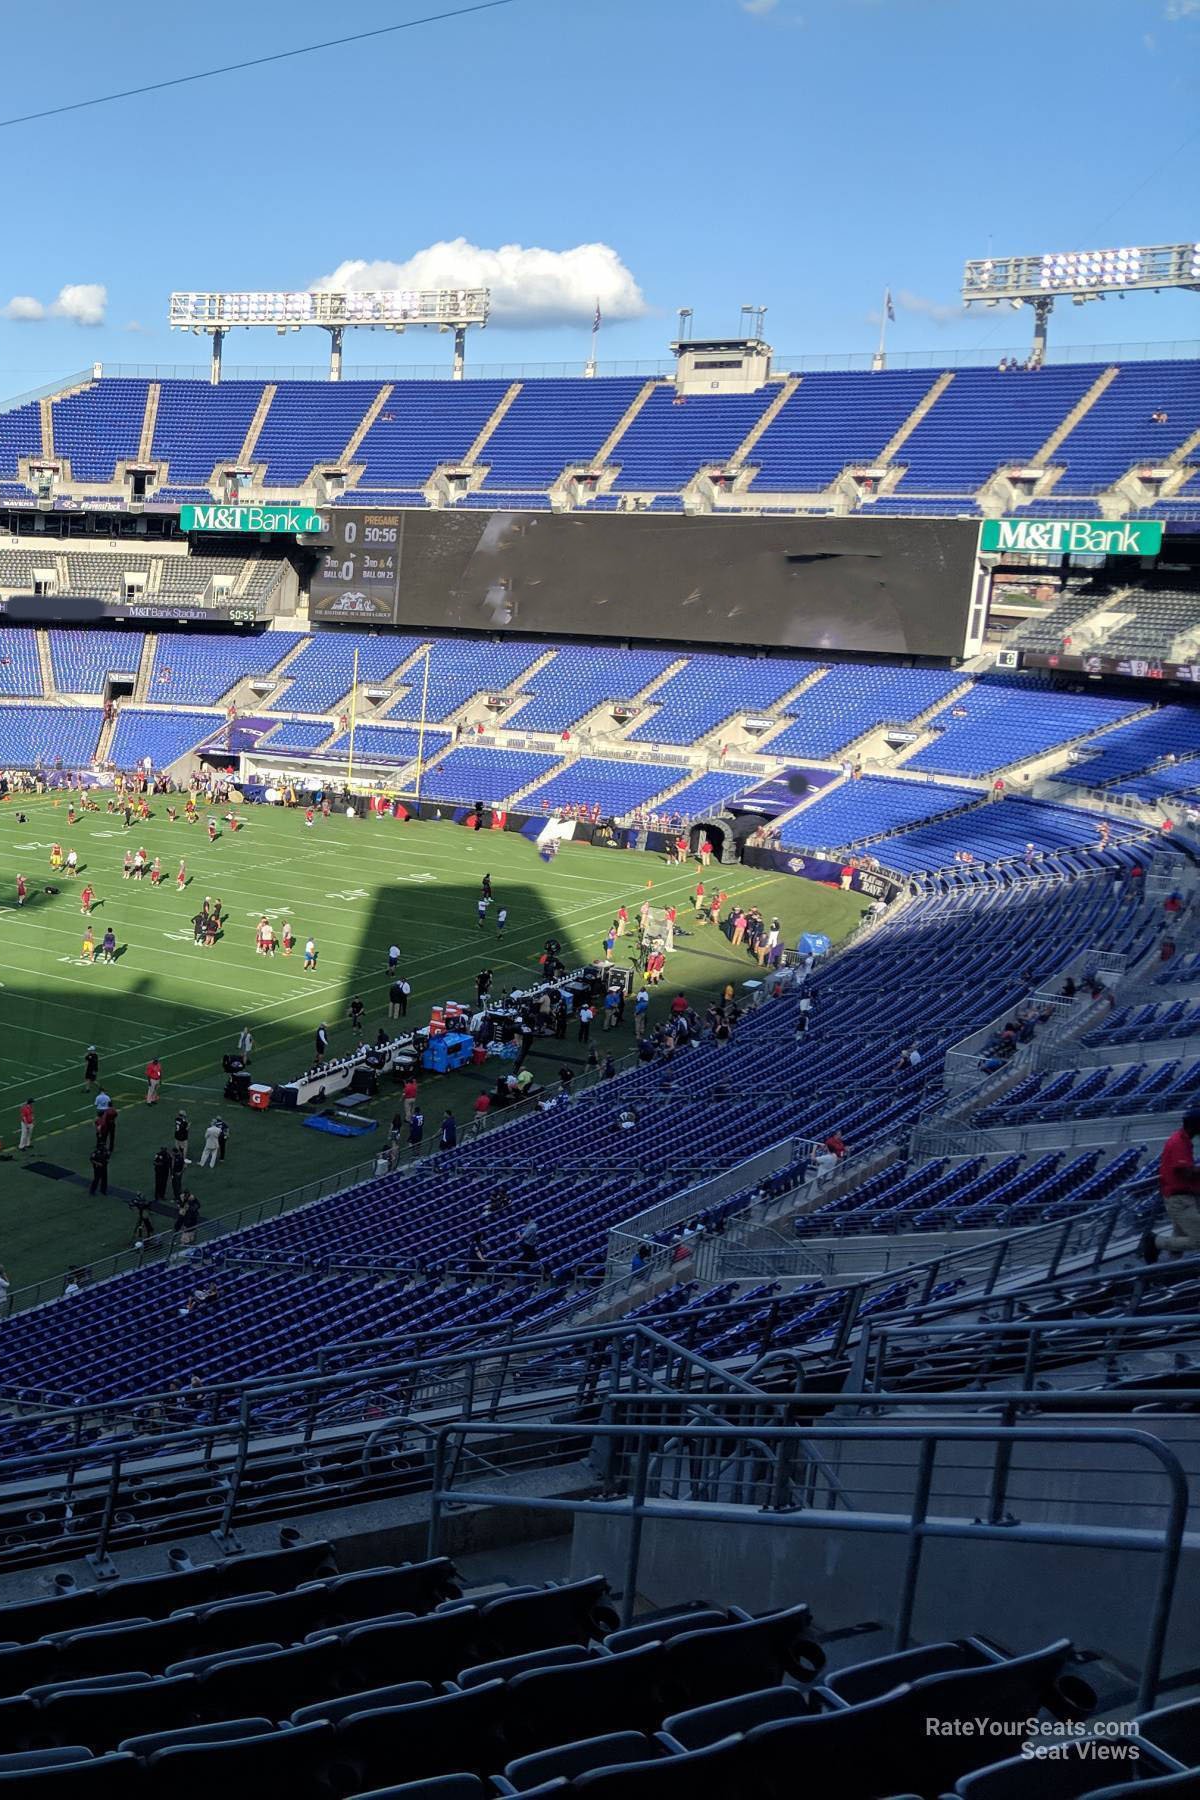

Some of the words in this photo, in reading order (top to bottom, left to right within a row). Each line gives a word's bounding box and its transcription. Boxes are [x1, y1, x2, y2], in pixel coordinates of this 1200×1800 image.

[193, 507, 247, 529] M&T
[248, 508, 302, 530] Bank
[364, 515, 400, 526] PREGAME
[345, 522, 357, 543] 0
[364, 528, 397, 542] 50:56
[997, 521, 1070, 550] M&T
[1070, 522, 1140, 552] Bank
[386, 556, 393, 568] 4
[342, 560, 354, 580] 0
[386, 571, 394, 579] 25
[173, 608, 207, 619] Stadium
[859, 872, 877, 885] PLAY
[252, 1093, 261, 1104] G
